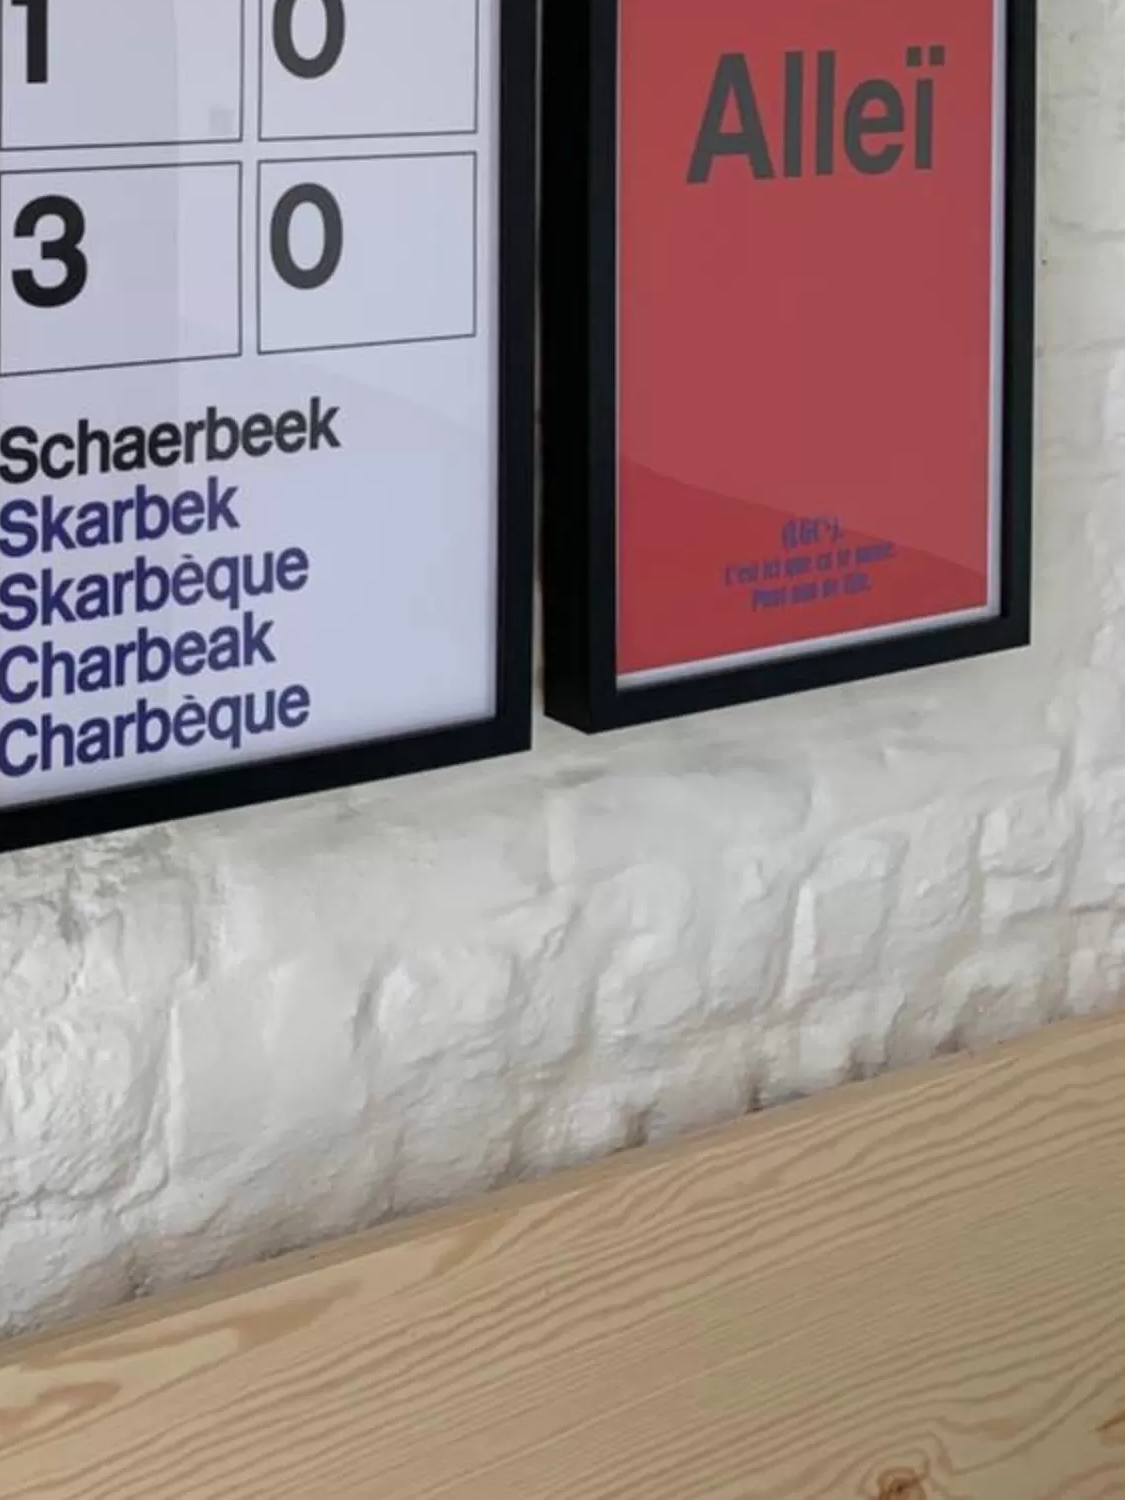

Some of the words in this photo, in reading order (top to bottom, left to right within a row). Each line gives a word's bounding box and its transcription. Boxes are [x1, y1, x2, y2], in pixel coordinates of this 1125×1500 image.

[685, 45, 946, 185] Alleï
[11, 194, 88, 309] 3
[269, 182, 344, 291] 0
